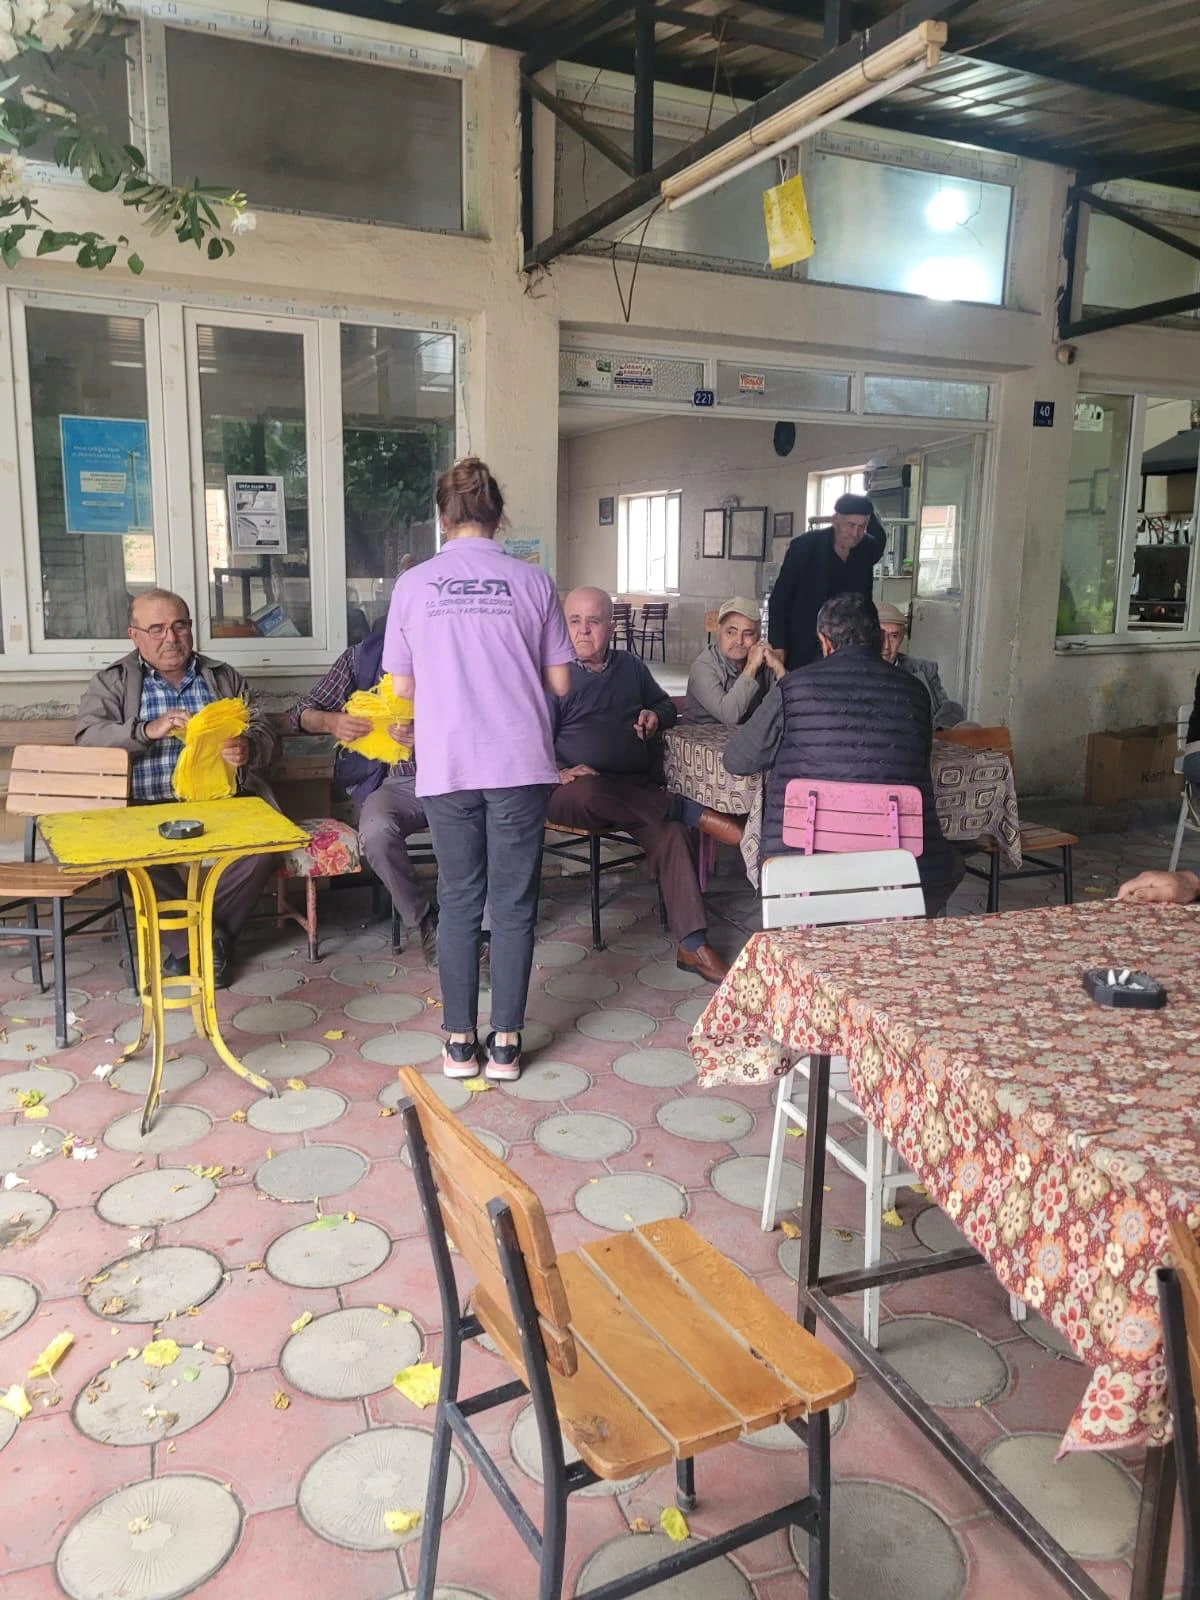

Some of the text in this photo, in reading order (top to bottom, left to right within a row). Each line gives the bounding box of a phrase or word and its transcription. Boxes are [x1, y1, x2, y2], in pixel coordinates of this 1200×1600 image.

[695, 392, 712, 405] 221
[1039, 405, 1051, 417] 40
[447, 579, 512, 597] GESA
